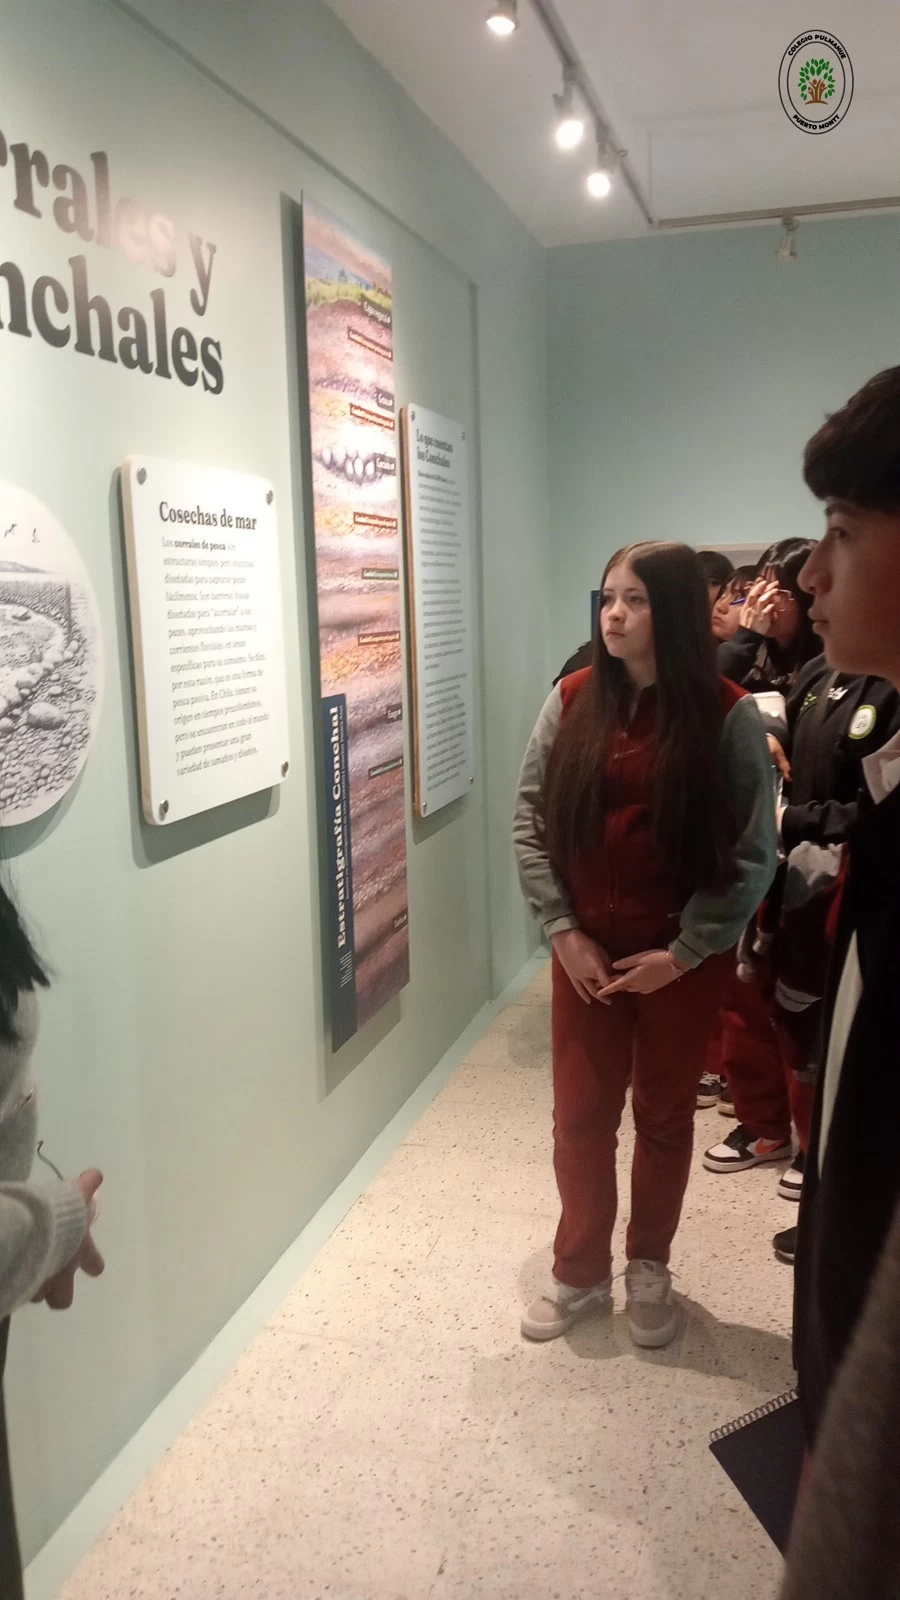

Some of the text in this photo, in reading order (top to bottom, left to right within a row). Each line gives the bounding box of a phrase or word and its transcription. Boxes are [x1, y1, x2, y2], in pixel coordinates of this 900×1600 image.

[0, 129, 217, 316] rales y
[159, 501, 257, 530] Cosechas de mar
[174, 539, 200, 548] corrales
[210, 543, 225, 551] pesca
[329, 706, 341, 801] Conchal
[333, 803, 346, 949] Estratigrafía
